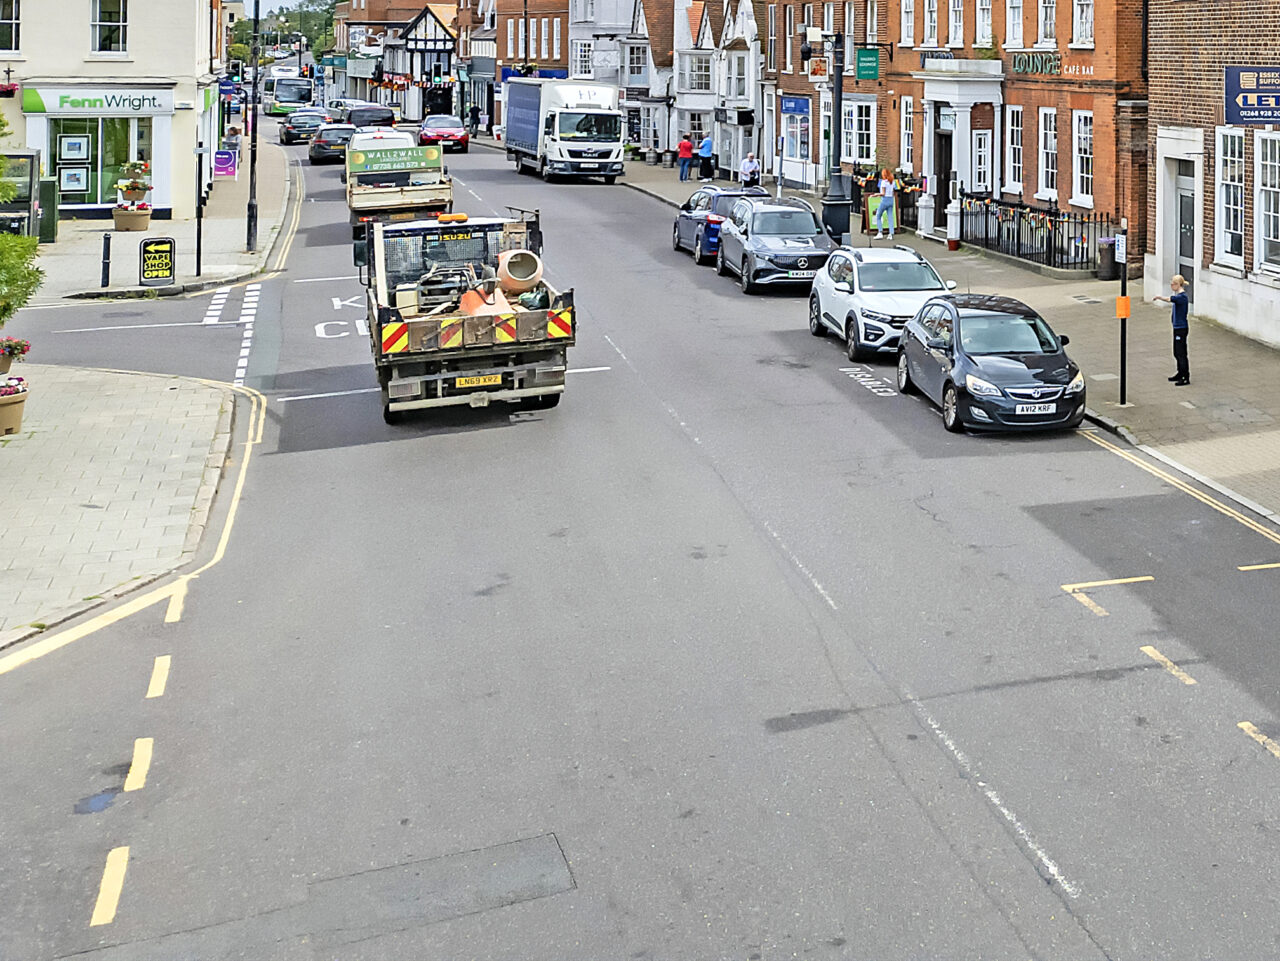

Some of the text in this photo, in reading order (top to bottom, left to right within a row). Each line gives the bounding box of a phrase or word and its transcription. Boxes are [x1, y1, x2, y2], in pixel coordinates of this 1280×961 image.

[1012, 52, 1061, 74] LOUNGE
[1081, 65, 1094, 75] BAR
[439, 233, 471, 241] ISUZU
[145, 253, 170, 262] VAPE
[145, 262, 171, 270] SHOP
[144, 270, 171, 279] OPEN
[839, 367, 898, 397] DISABLED
[1020, 404, 1051, 413] AV12 KRF
